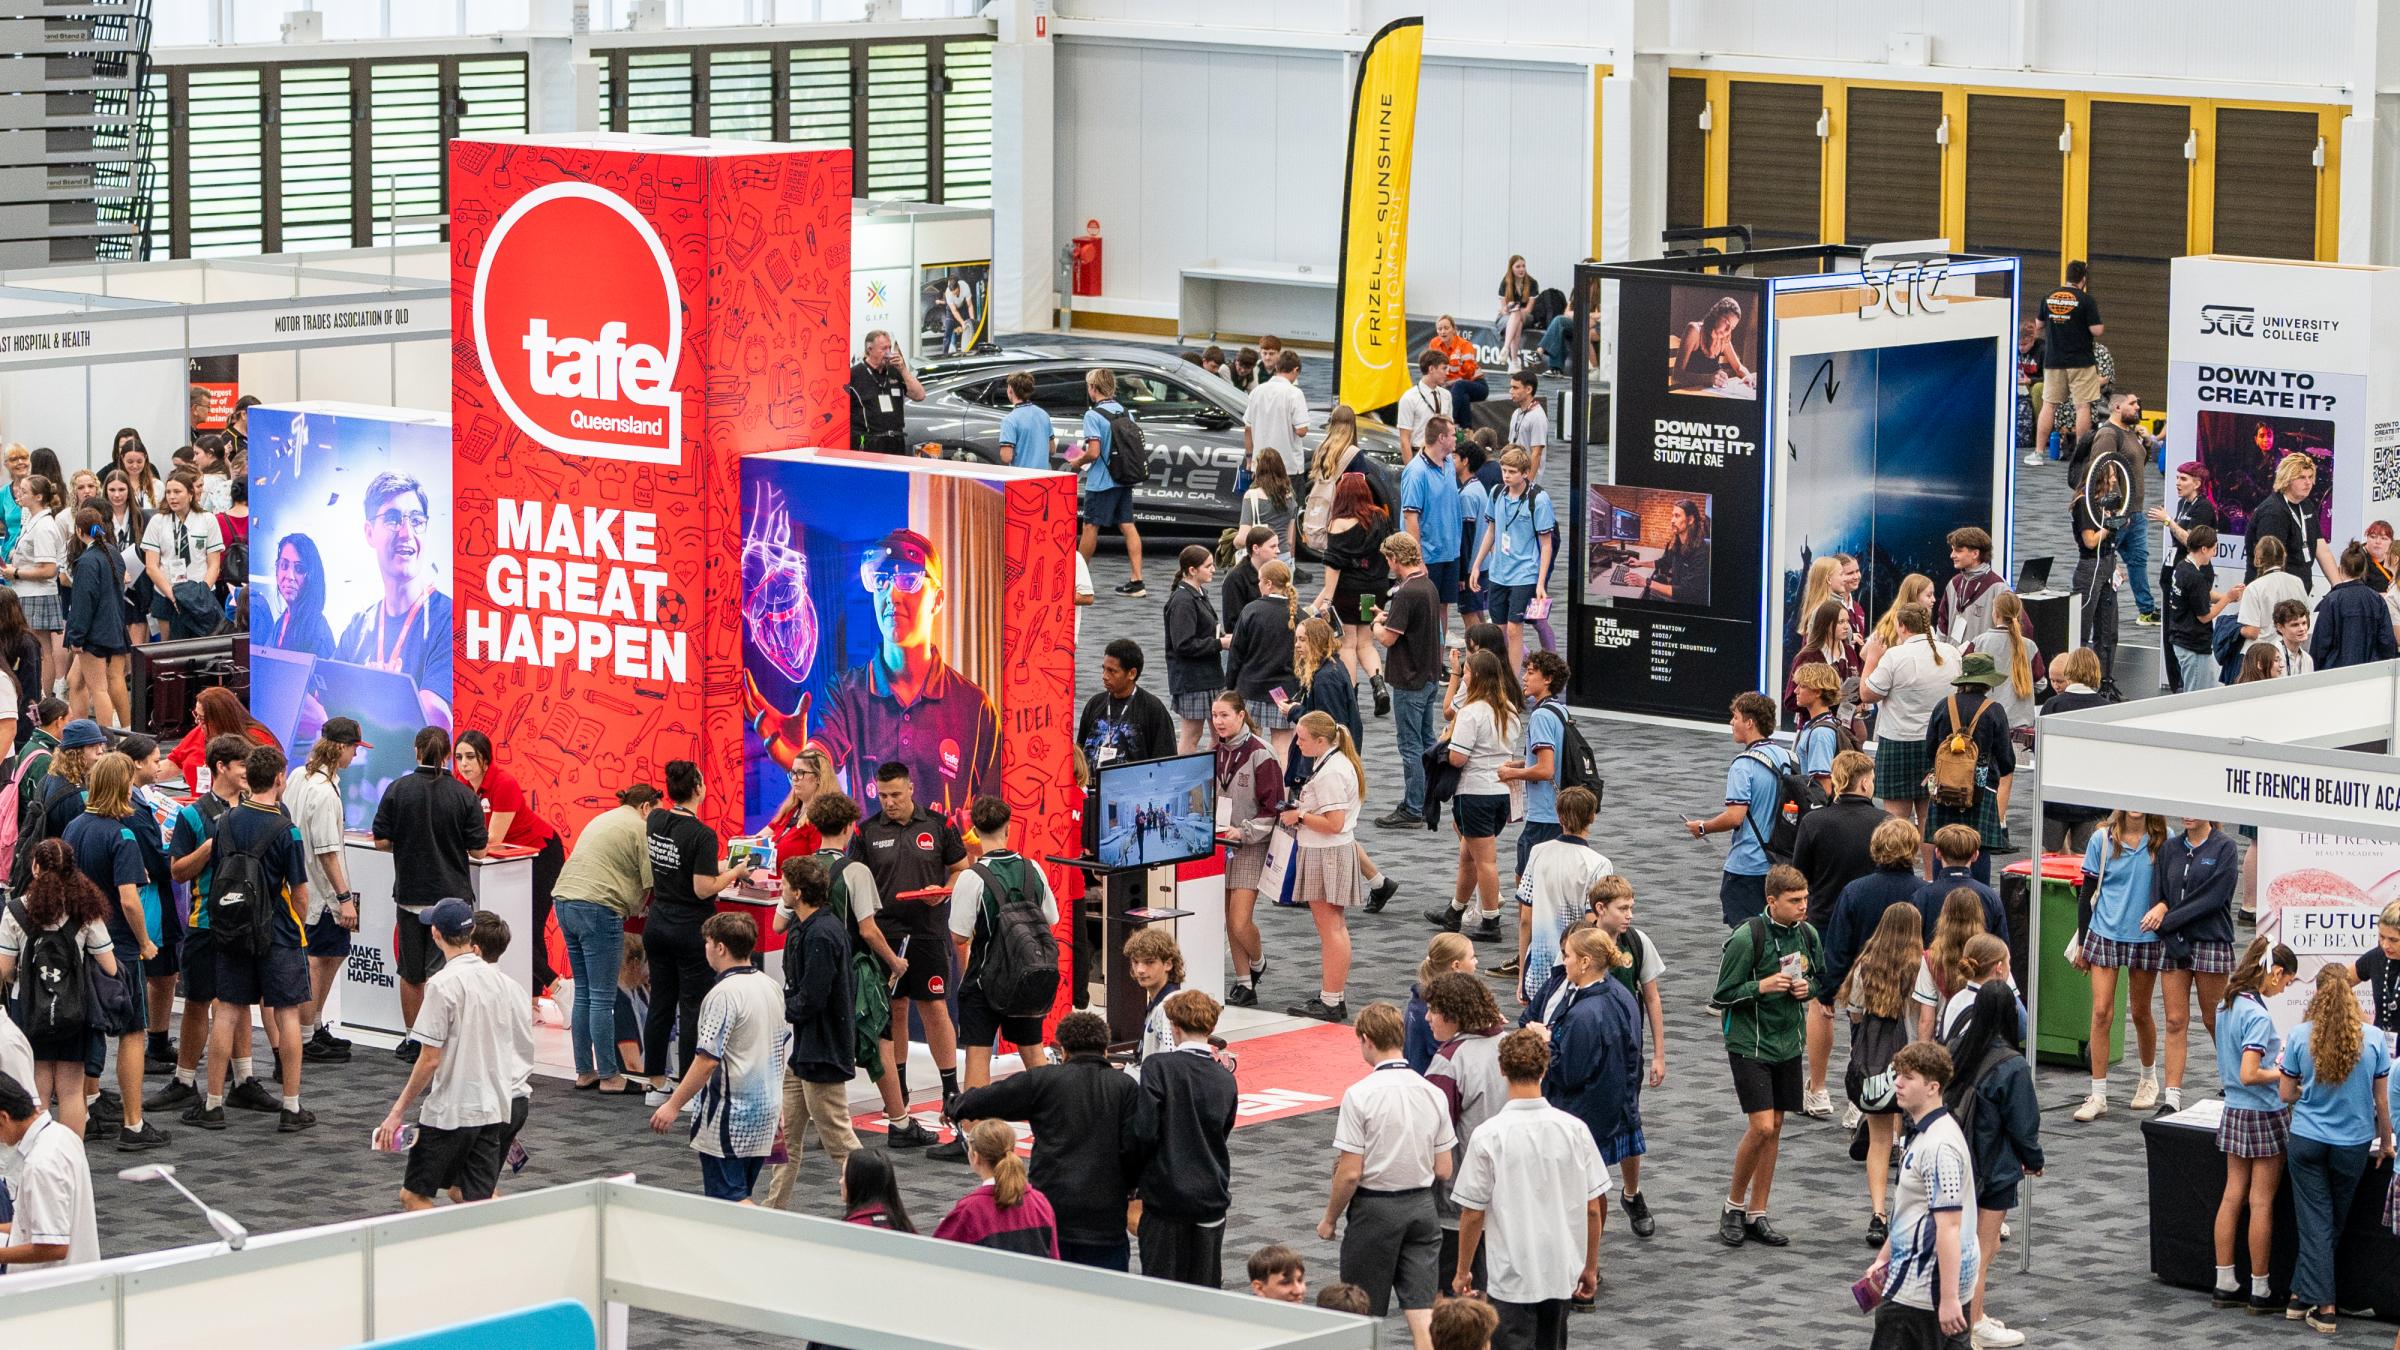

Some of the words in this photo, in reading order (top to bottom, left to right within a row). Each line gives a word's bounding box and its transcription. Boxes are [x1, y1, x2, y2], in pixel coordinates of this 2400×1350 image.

[1377, 93, 1392, 223] SUNSHINE
[275, 315, 300, 332] MOTOR
[303, 314, 332, 330] TRADES
[334, 310, 382, 329] ASSOCIATION
[384, 309, 392, 324] OF
[395, 308, 408, 324] QLD
[2262, 316, 2340, 332] UNIVERSITY
[14, 332, 50, 352] HOSPITAL
[54, 332, 60, 348] &
[62, 330, 90, 348] HEALTH
[2262, 330, 2320, 342] COLLEGE
[522, 318, 670, 406] tafe
[2198, 364, 2276, 388] DOWN
[2281, 372, 2314, 390] TO
[2198, 386, 2294, 408] CREATE
[2299, 393, 2337, 412] IT?
[570, 409, 663, 436] Queensland
[1654, 419, 1712, 438] DOWN
[1714, 424, 1740, 440] TO
[2374, 422, 2392, 430] DOWN
[2374, 428, 2394, 436] CREATE
[1654, 434, 1725, 454] CREATE
[1727, 441, 1756, 456] IT?
[1144, 443, 1247, 469] ANG
[1654, 448, 1686, 464] STUDY
[1688, 452, 1702, 466] AT
[1704, 453, 1724, 468] SAE
[1147, 490, 1183, 498] LOAN
[1188, 492, 1216, 500] CAR
[496, 498, 657, 564] MAKE
[486, 554, 668, 622] GREAT
[1594, 617, 1618, 627] THE
[1594, 626, 1640, 639] FUTURE
[1594, 634, 1606, 644] IS
[1608, 636, 1631, 646] YOU
[466, 609, 688, 683] HAPPEN
[1652, 640, 1678, 649] CREATIVE
[944, 752, 959, 766] tafe
[2226, 768, 2251, 794] THE
[2256, 771, 2310, 802] FRENCH
[2315, 778, 2370, 808] BEAUTY
[2294, 934, 2317, 948] OF
[350, 944, 381, 960] MAKE
[348, 956, 384, 974] GREAT
[348, 968, 394, 988] HAPPEN
